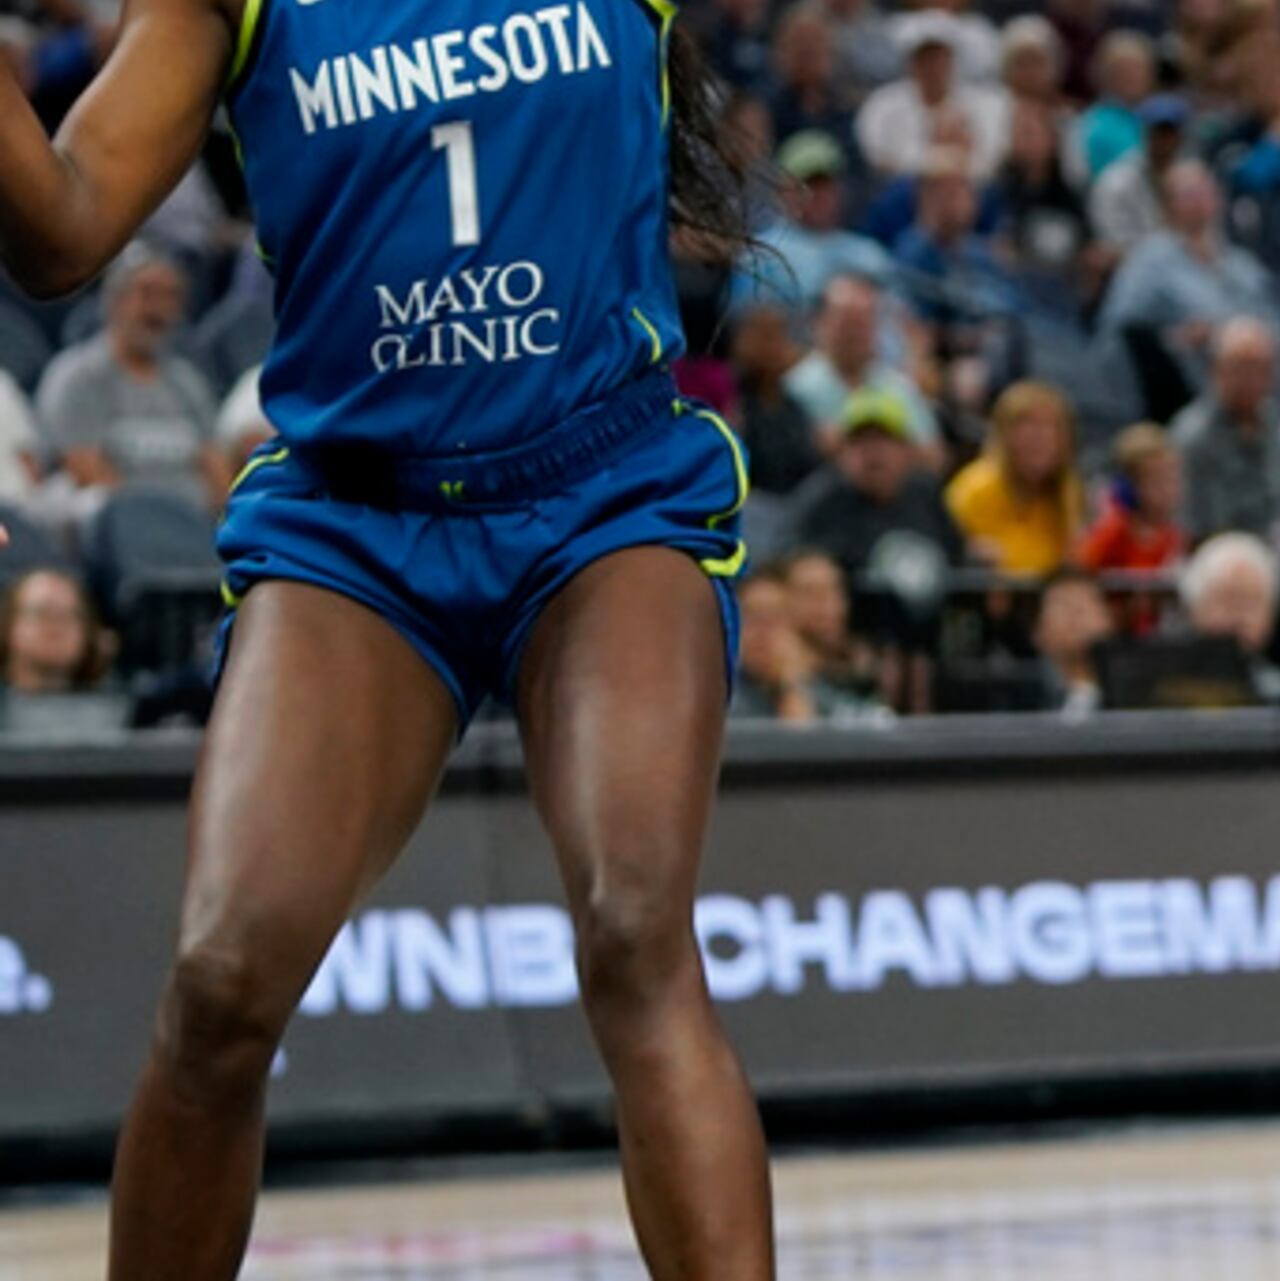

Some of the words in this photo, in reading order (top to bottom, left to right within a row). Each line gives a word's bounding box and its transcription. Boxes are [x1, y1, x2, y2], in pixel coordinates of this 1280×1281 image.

[289, 0, 612, 135] MINNESOTA
[431, 120, 481, 247] 1
[370, 307, 560, 375] CLINIC
[374, 260, 544, 328] MAYO
[299, 903, 581, 1016] WNB
